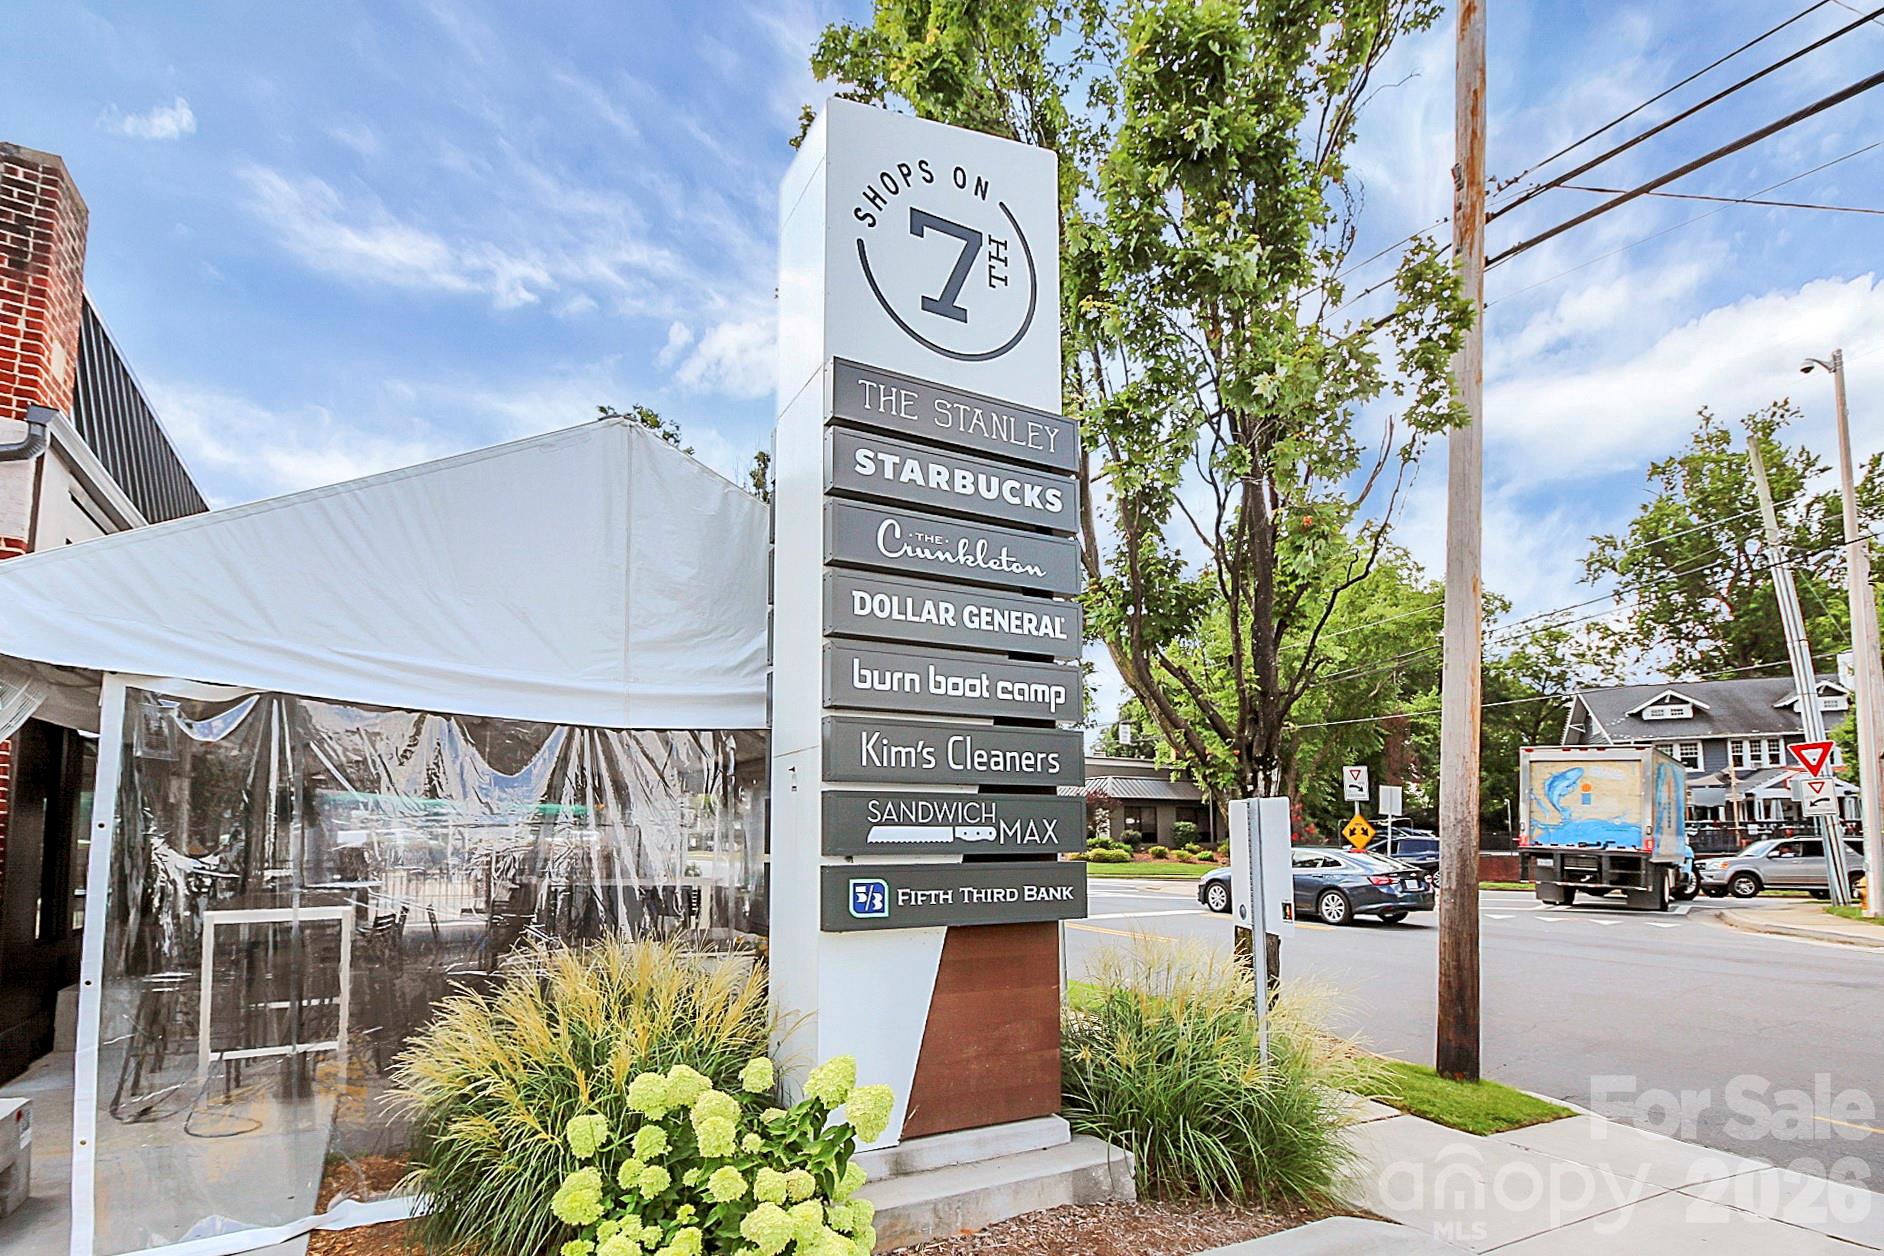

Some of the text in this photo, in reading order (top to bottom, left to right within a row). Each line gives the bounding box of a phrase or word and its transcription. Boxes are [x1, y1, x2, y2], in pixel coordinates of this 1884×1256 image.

[854, 160, 989, 228] SHOPS ON
[858, 379, 1060, 453] THE STANLEY
[854, 448, 1064, 513] STARBUCKS
[876, 518, 1047, 578] Crunkleton
[915, 532, 944, 546] THE
[851, 590, 1068, 640] DOLLAR GENERAL
[852, 657, 1066, 713] burn boot camp
[860, 730, 1060, 774] Kim's Cleaners
[866, 799, 997, 824] SANDWICH
[999, 818, 1060, 845] MAX
[897, 884, 1075, 907] FIFTH THIRD BANK
